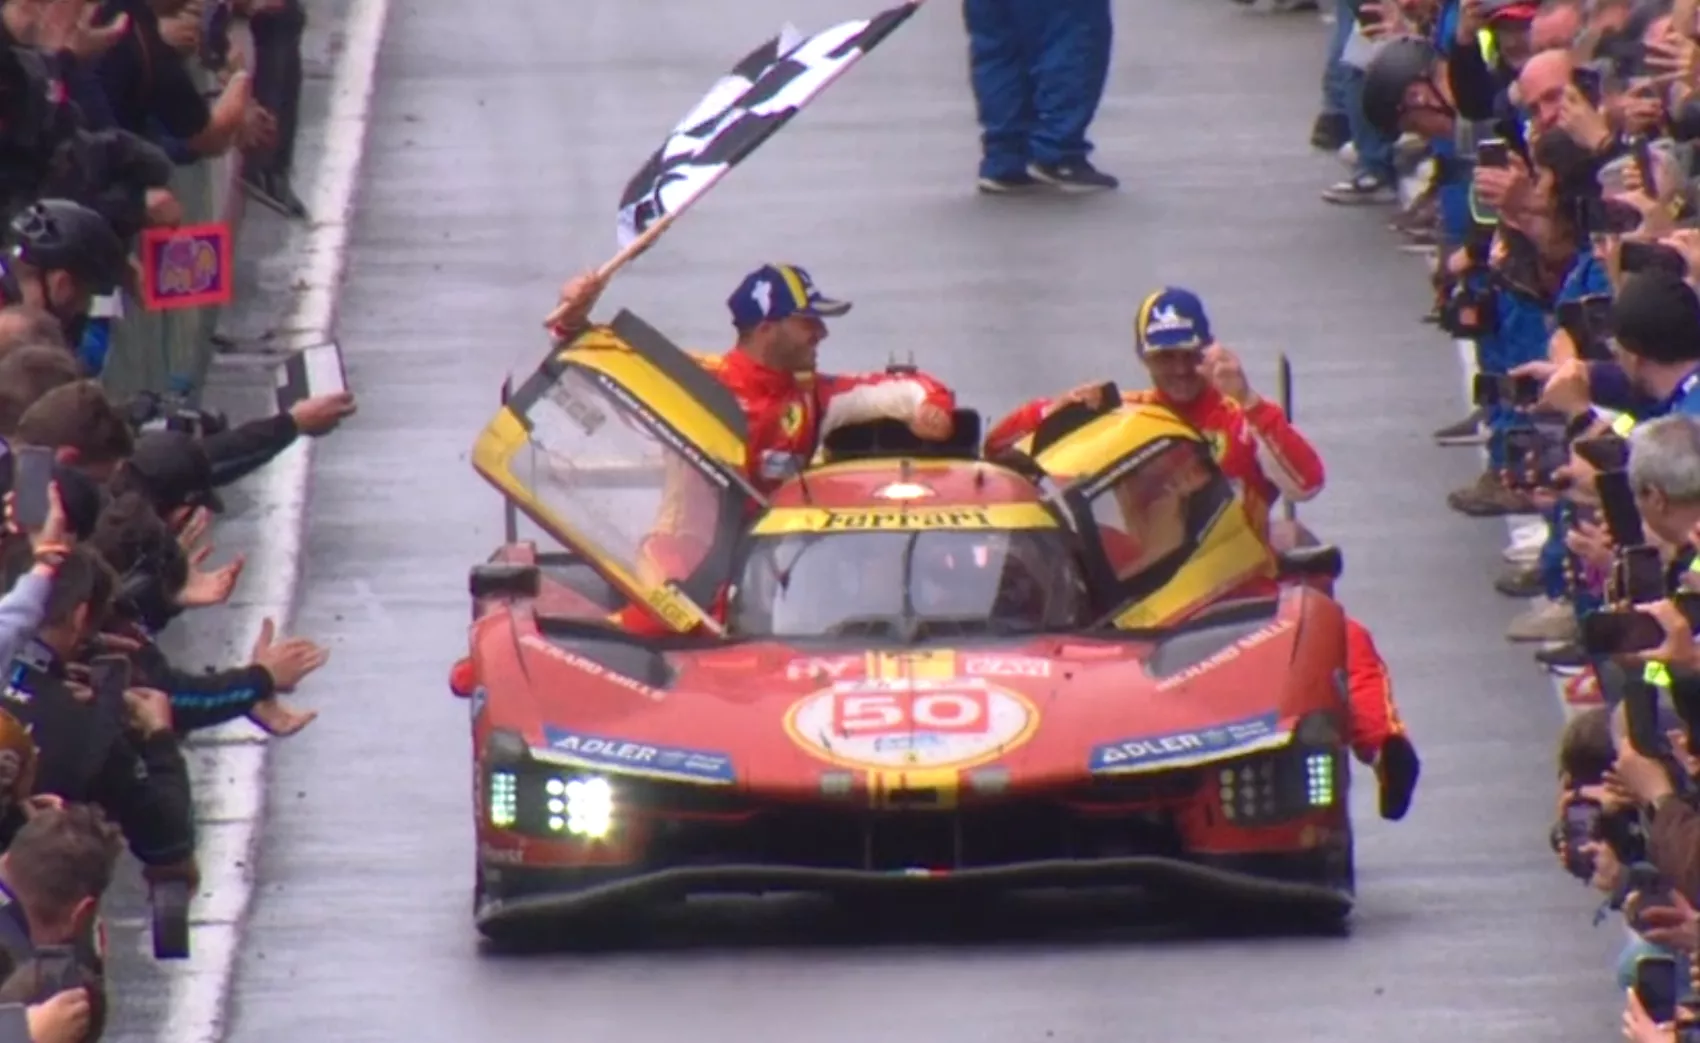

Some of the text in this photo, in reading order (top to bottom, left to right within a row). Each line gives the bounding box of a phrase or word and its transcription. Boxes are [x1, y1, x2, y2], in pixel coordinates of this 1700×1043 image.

[825, 505, 990, 529] Ferrari
[841, 694, 981, 730] 50
[554, 735, 657, 761] ADLER
[1102, 733, 1203, 762] ADLER
